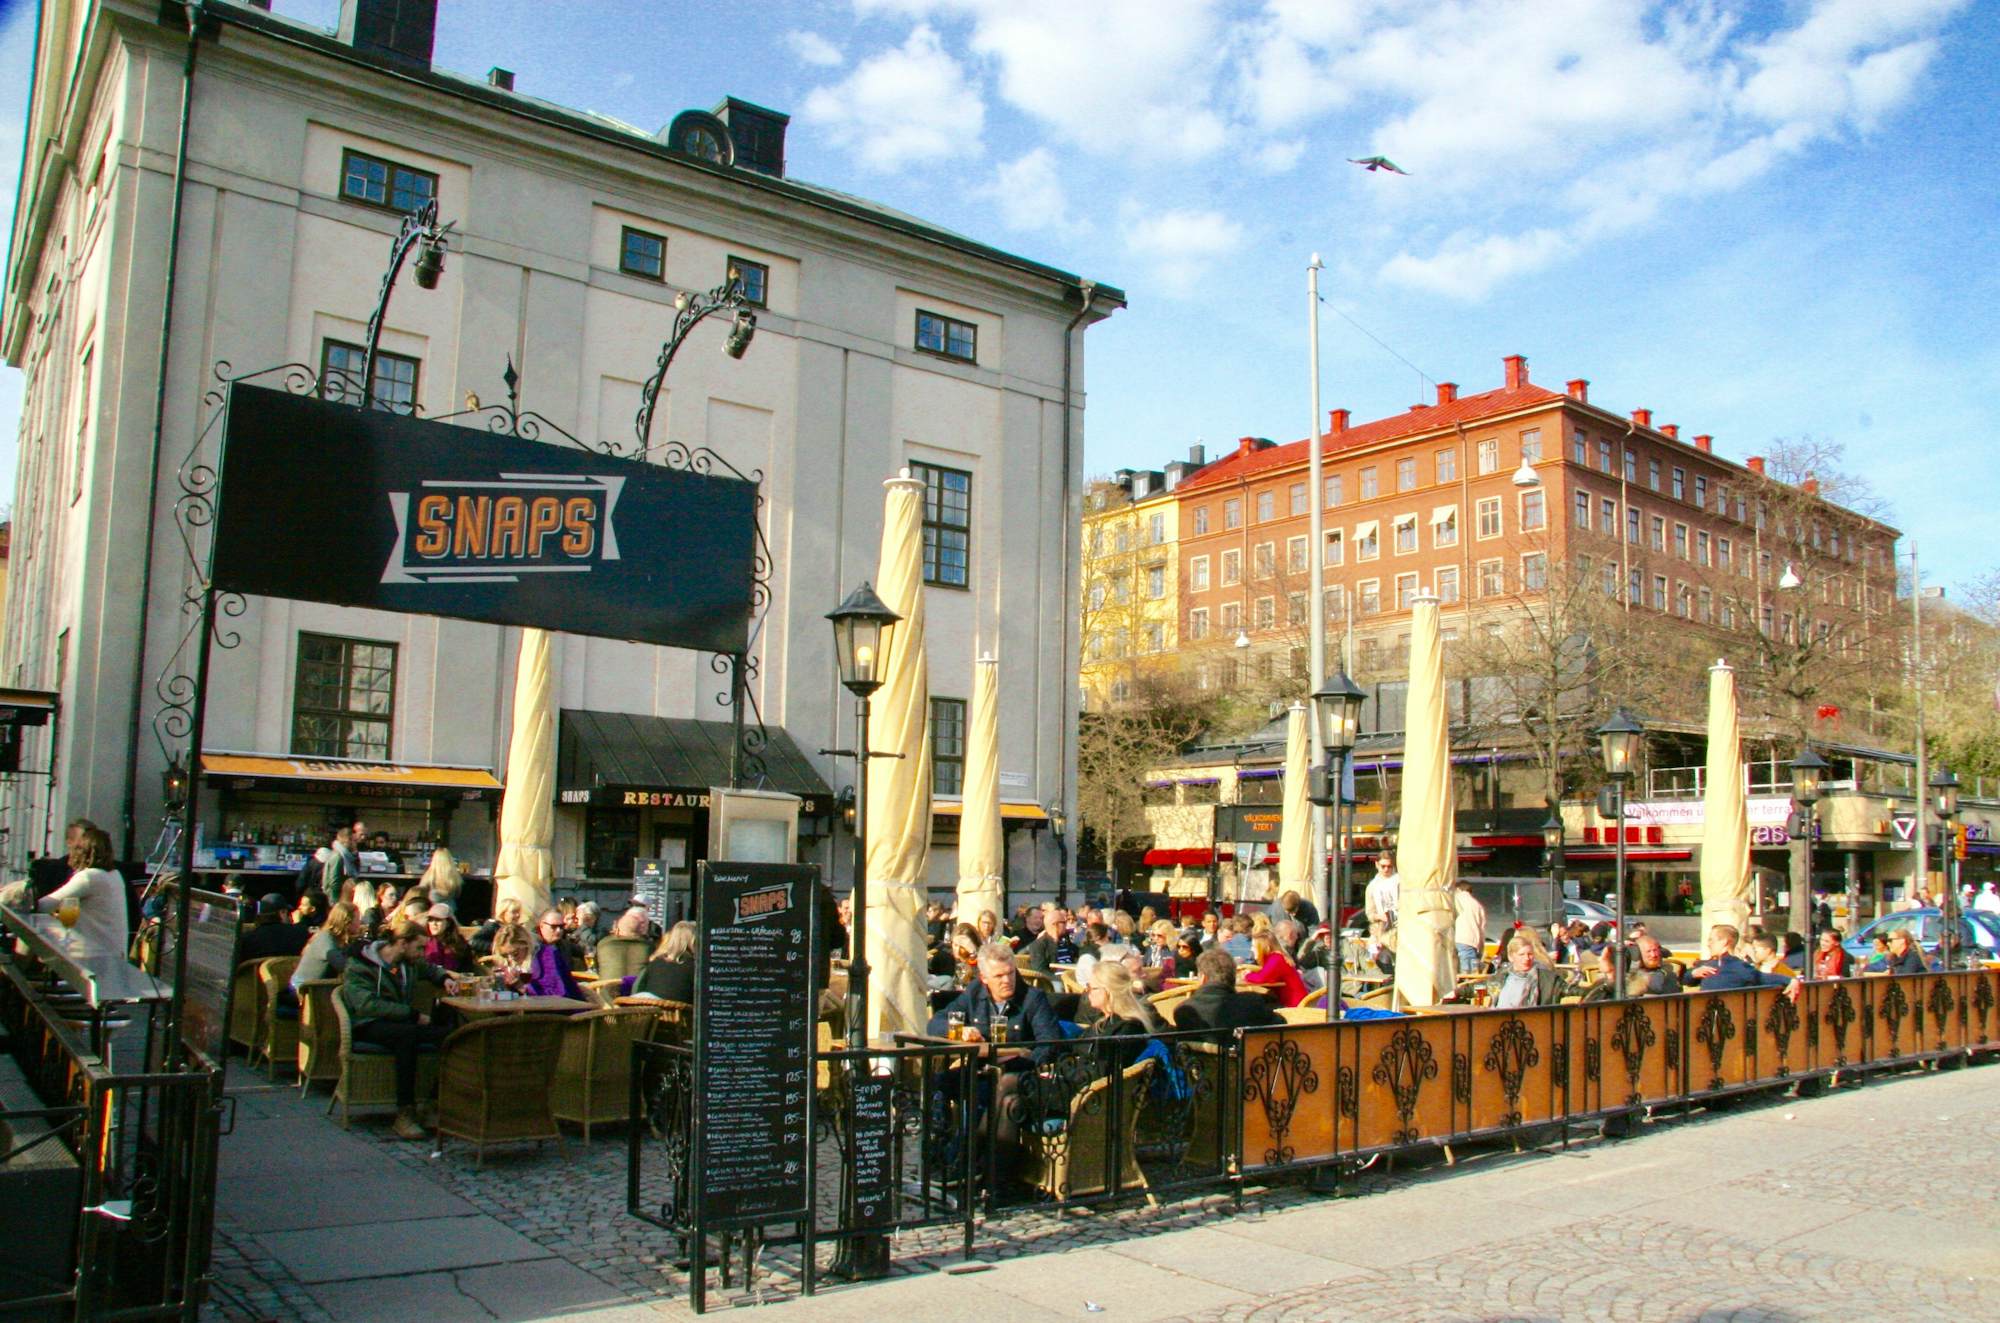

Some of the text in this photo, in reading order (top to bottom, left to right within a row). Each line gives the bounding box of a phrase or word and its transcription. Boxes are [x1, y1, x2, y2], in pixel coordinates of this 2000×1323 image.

[416, 495, 596, 559] SNAPS
[306, 783, 338, 793] BAR
[360, 785, 415, 797] BISTRO
[562, 790, 590, 803] SNAPS
[624, 791, 711, 808] RESTAUR
[740, 889, 787, 917] SNAPS
